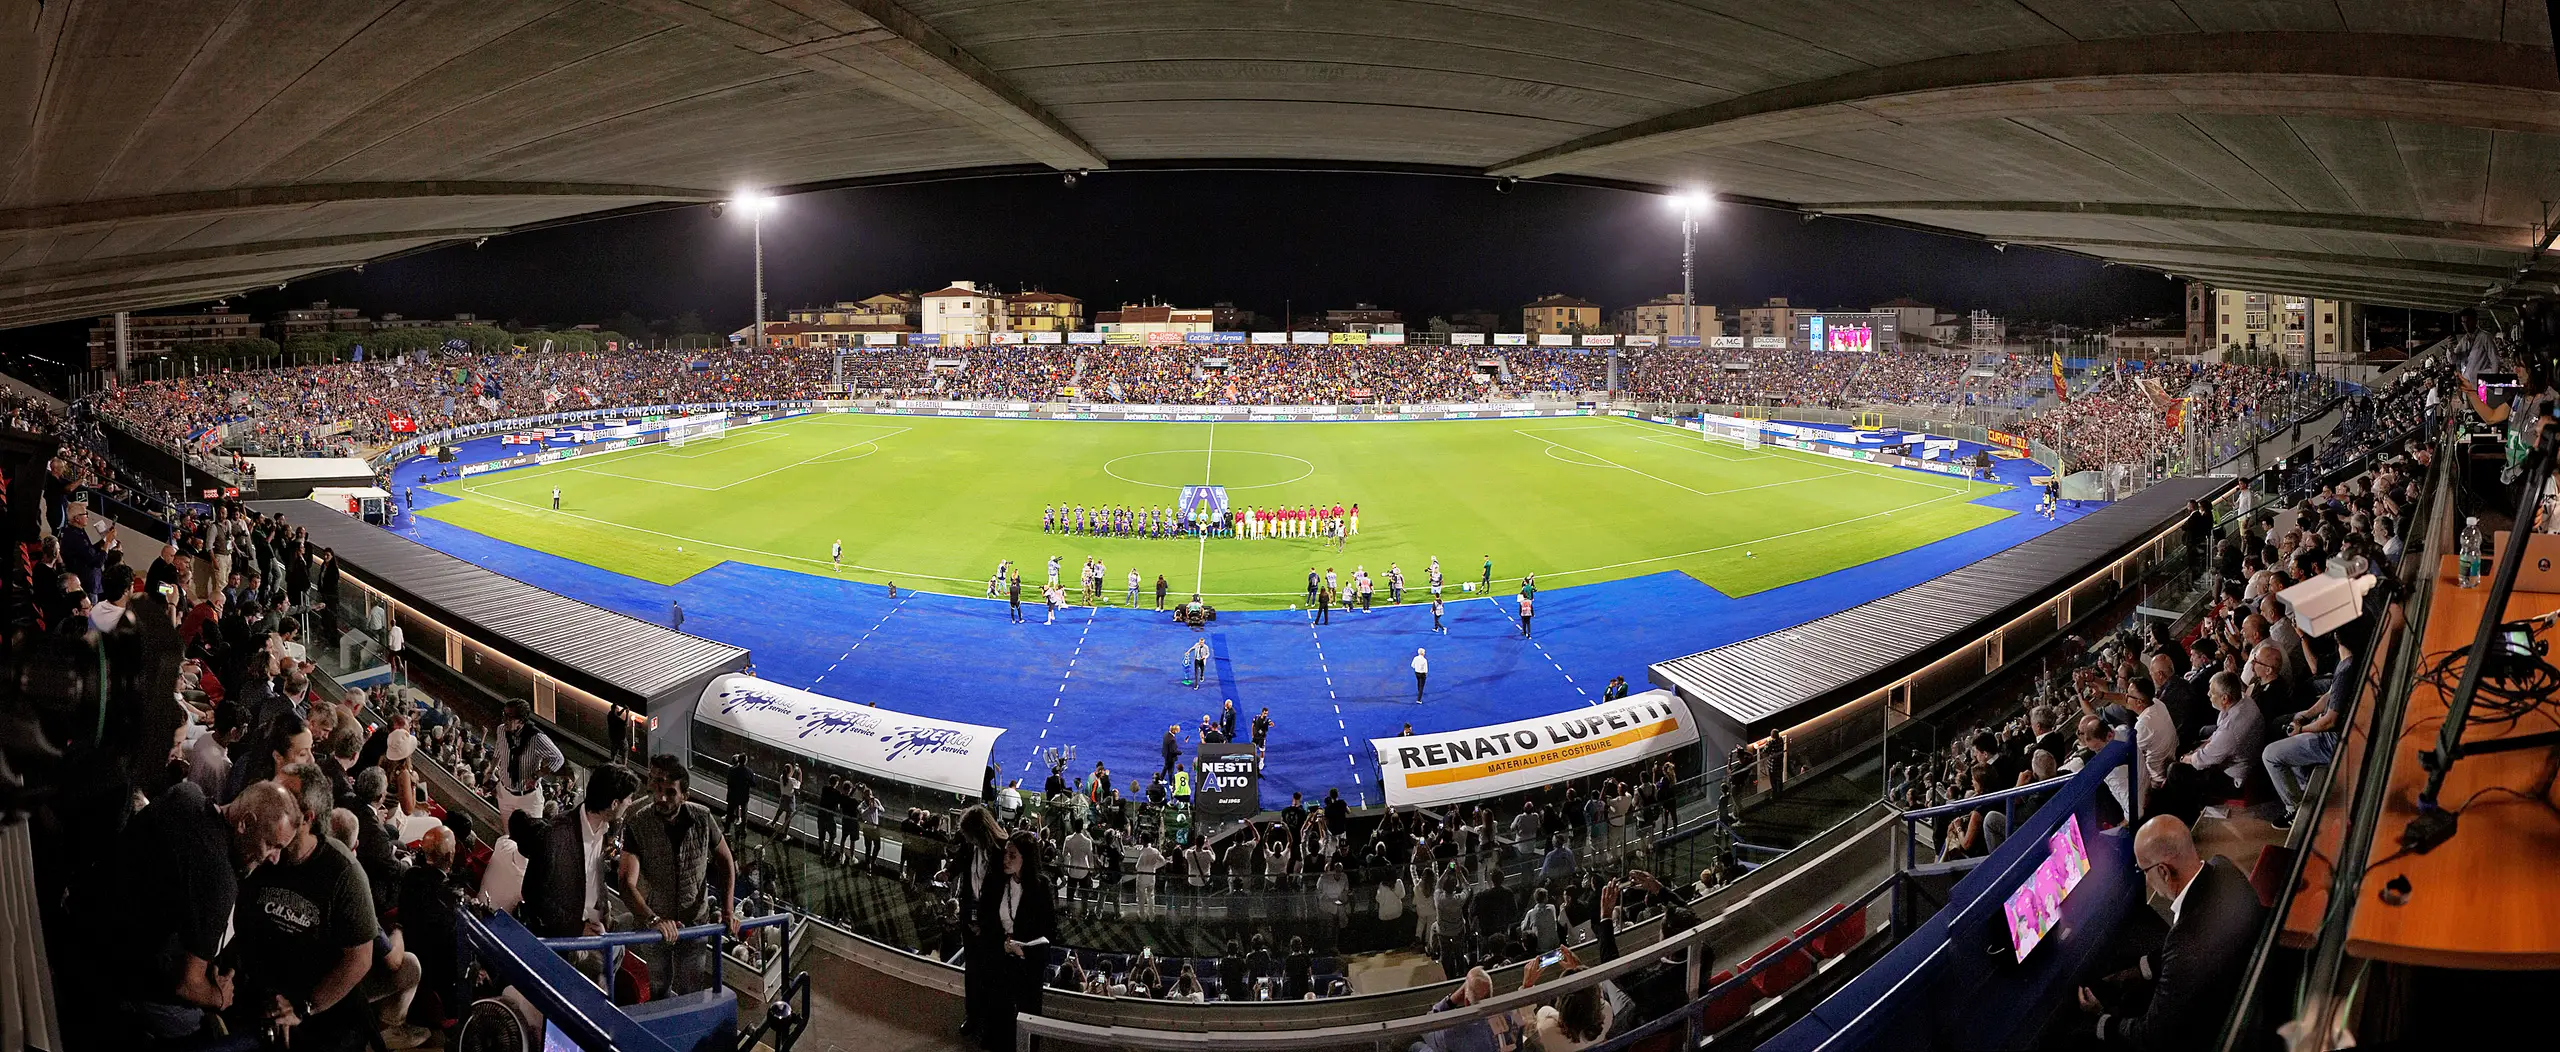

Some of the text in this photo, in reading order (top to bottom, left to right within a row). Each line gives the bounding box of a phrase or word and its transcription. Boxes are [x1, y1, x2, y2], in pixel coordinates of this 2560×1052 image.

[875, 406, 915, 415] betwin360.tv
[938, 408, 981, 416] betwin360.tv
[1052, 412, 1098, 421] betwin360.tv
[1312, 413, 1360, 422] betwin360.tv
[1373, 412, 1420, 421] betwin360.tv
[1249, 414, 1298, 422] betwin360.tv
[404, 442, 419, 455] PER
[443, 429, 452, 443] IN
[455, 425, 478, 439] ALTO
[481, 421, 490, 434] SI
[562, 411, 598, 424] FORTE
[602, 409, 617, 420] LA
[622, 404, 671, 418] CANZONE
[678, 404, 711, 415] DEGLI
[605, 436, 646, 451] betwin360.tv
[534, 447, 583, 464] betwin360.tv
[461, 460, 512, 475] betwin360.tv
[1922, 461, 1973, 477] betwin360.tv
[768, 703, 792, 716] service
[832, 709, 882, 729] DEMA
[849, 724, 877, 738] service
[922, 727, 975, 747] DEMA
[1397, 701, 1673, 769] RENATO LUPETTI
[941, 744, 969, 756] service
[1487, 739, 1612, 773] MATERIALI PER COSTRUIRE
[1201, 762, 1253, 773] NESTI
[1180, 776, 1186, 787] 8
[1200, 771, 1249, 793] AUTO
